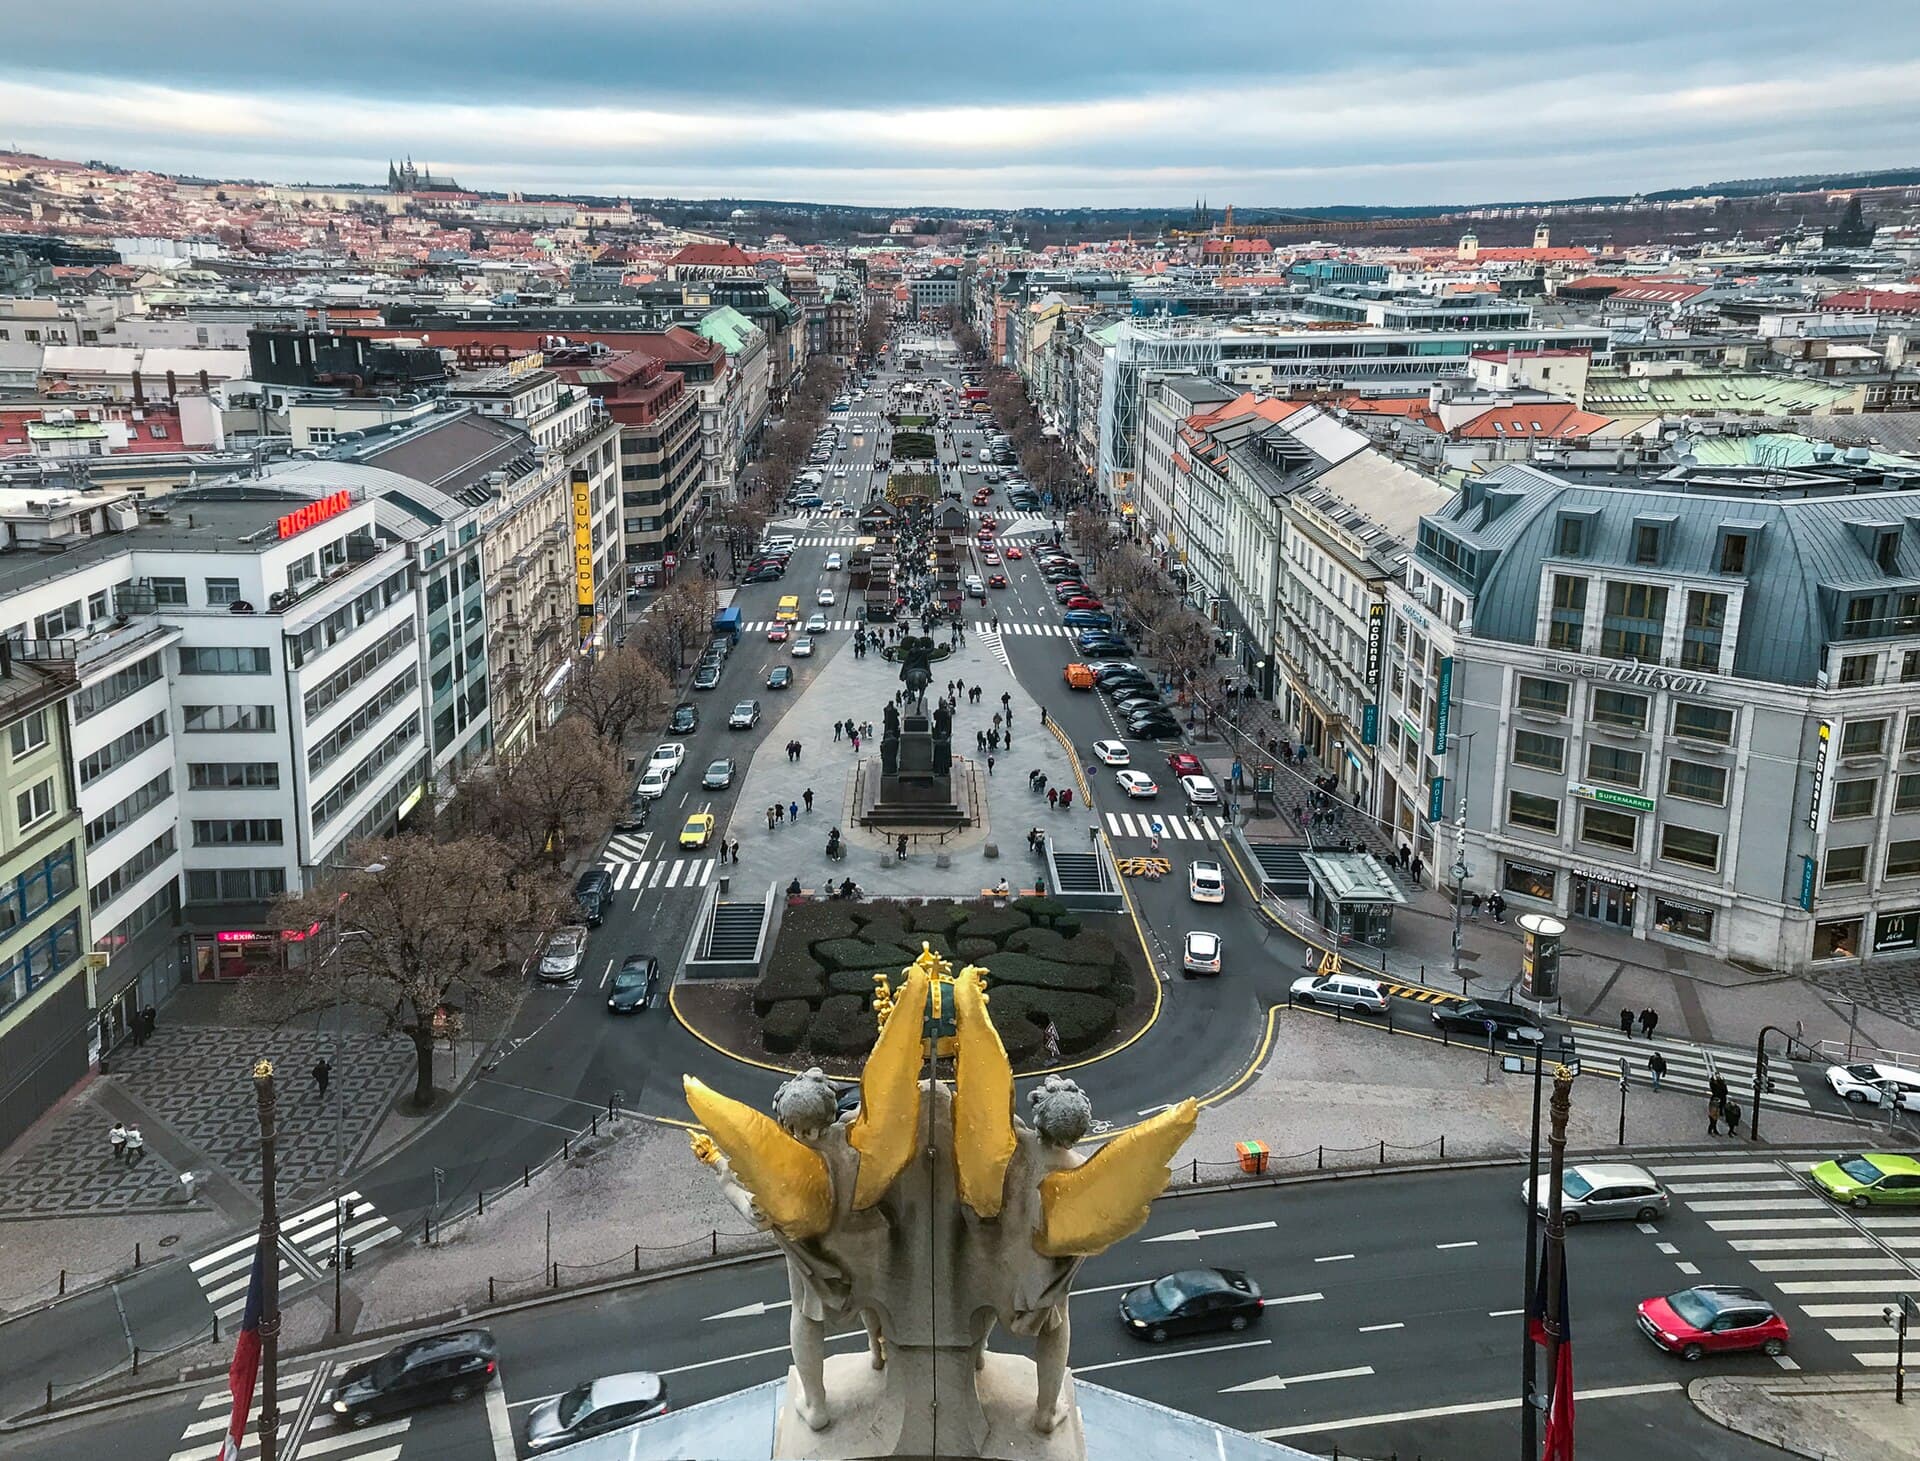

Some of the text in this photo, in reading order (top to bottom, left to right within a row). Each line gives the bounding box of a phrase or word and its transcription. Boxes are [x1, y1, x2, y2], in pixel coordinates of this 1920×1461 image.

[278, 488, 350, 539] RICHMAN
[634, 564, 654, 573] KFC
[1368, 618, 1381, 684] McDonald's
[1605, 656, 1707, 694] Wilson
[1366, 708, 1375, 742] HOTEL
[1433, 780, 1441, 819] HOTEL
[1598, 792, 1651, 808] SUPERMARKET
[1803, 862, 1812, 905] HOTEL
